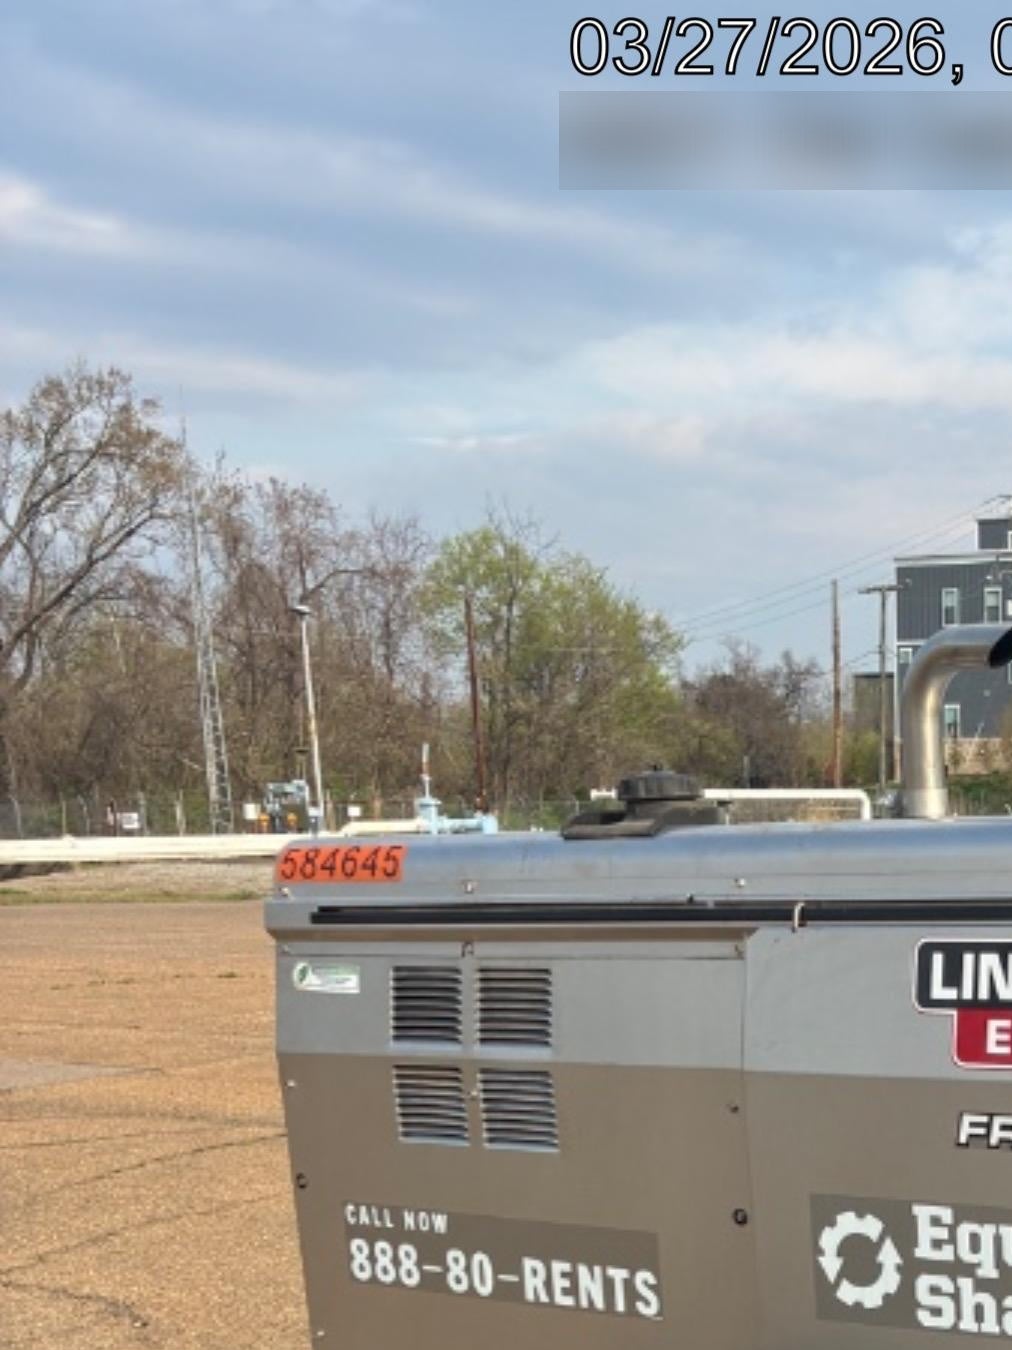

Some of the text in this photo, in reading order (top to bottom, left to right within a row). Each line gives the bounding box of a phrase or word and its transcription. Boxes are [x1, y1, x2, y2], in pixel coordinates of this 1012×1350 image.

[280, 845, 403, 880] 584645
[345, 1203, 448, 1234] CALL NOW
[350, 1237, 660, 1318] 888-80-RENTS
